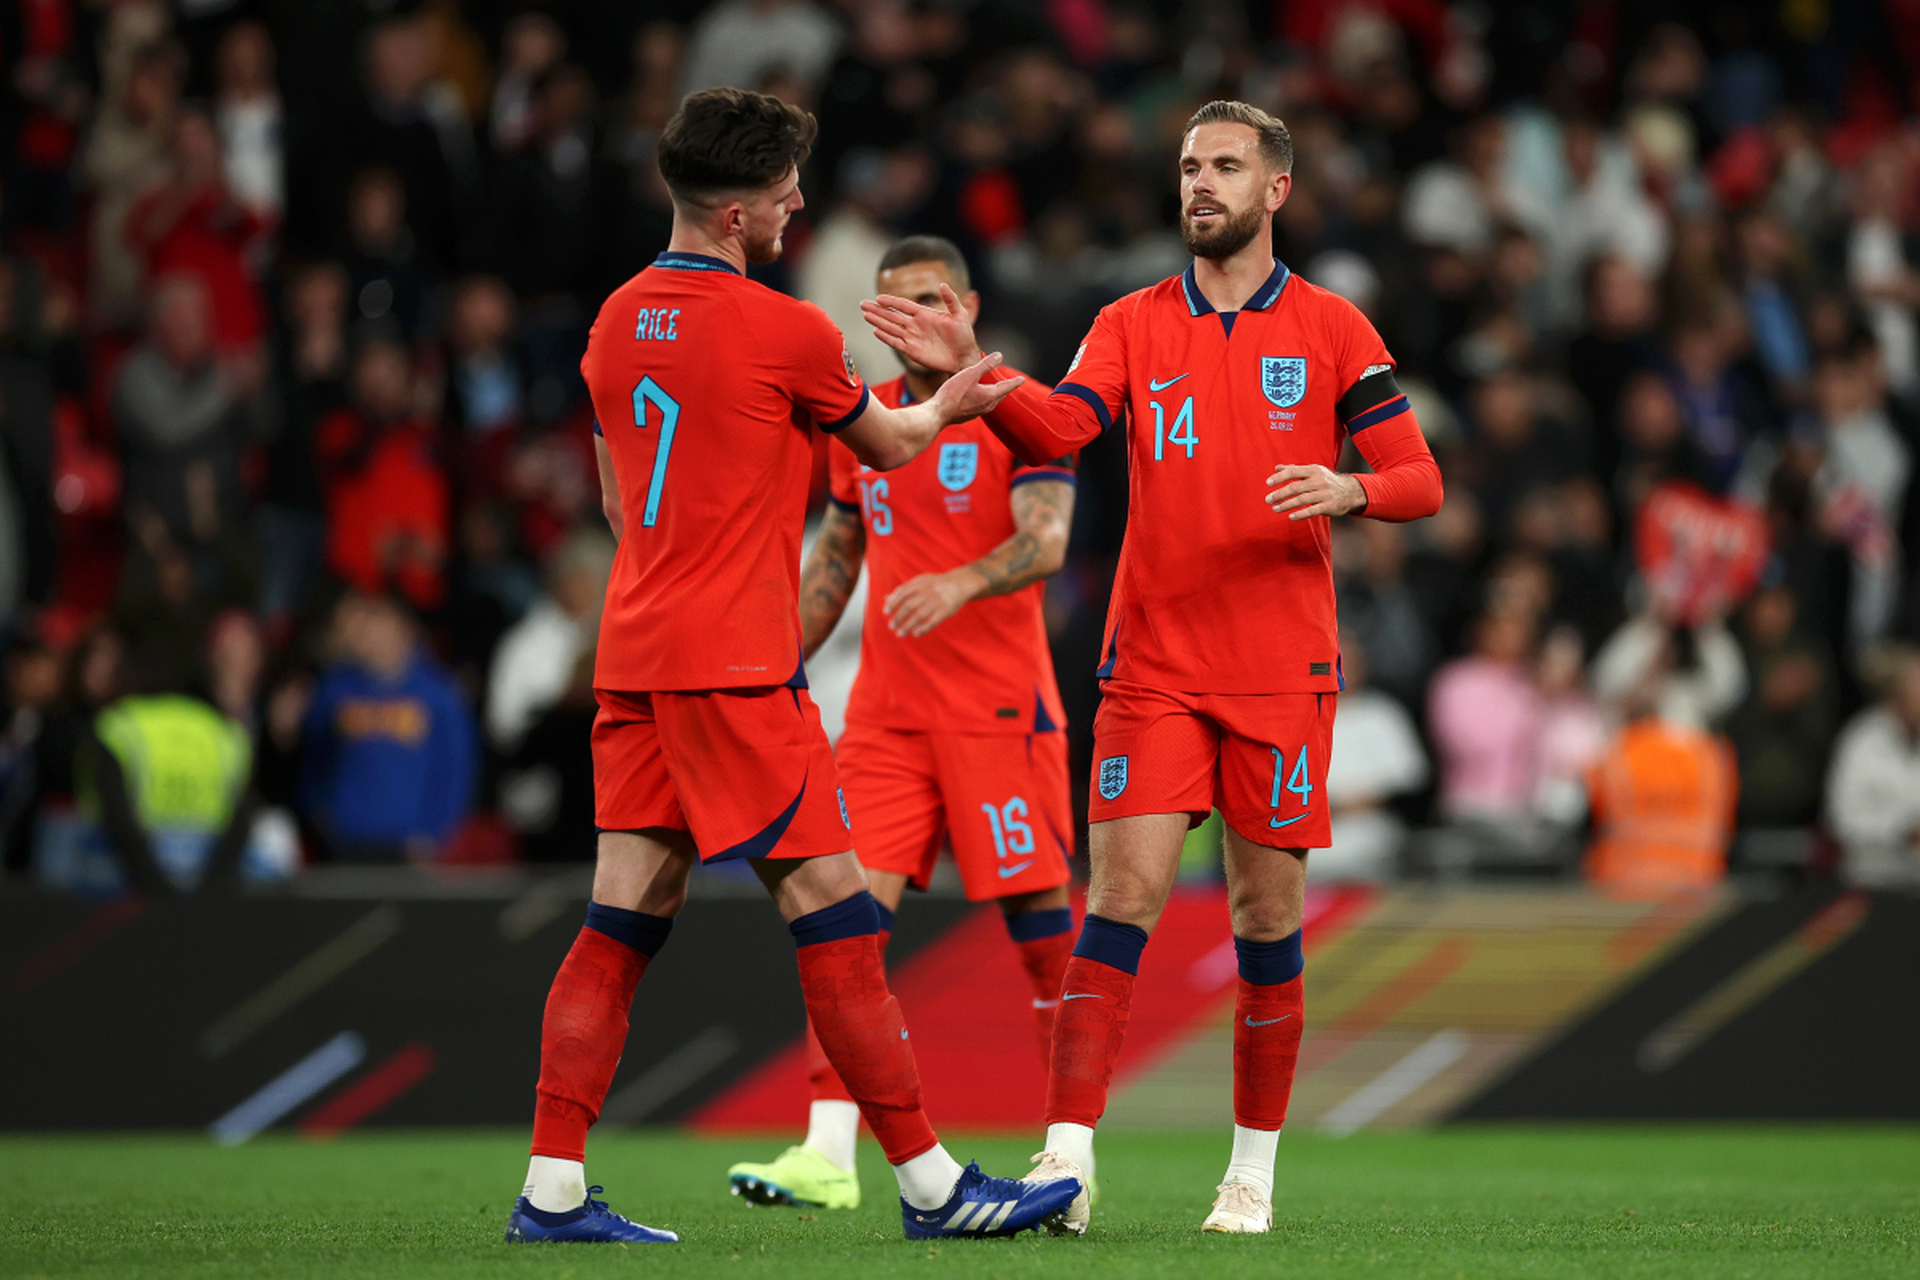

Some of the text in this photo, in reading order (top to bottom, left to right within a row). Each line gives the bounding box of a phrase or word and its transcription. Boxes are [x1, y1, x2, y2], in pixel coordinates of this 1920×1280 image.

[635, 308, 681, 341] RICE
[631, 373, 682, 529] 7
[1149, 394, 1200, 462] 14
[859, 476, 894, 536] 15
[1269, 743, 1314, 809] 14
[981, 795, 1036, 859] 15
